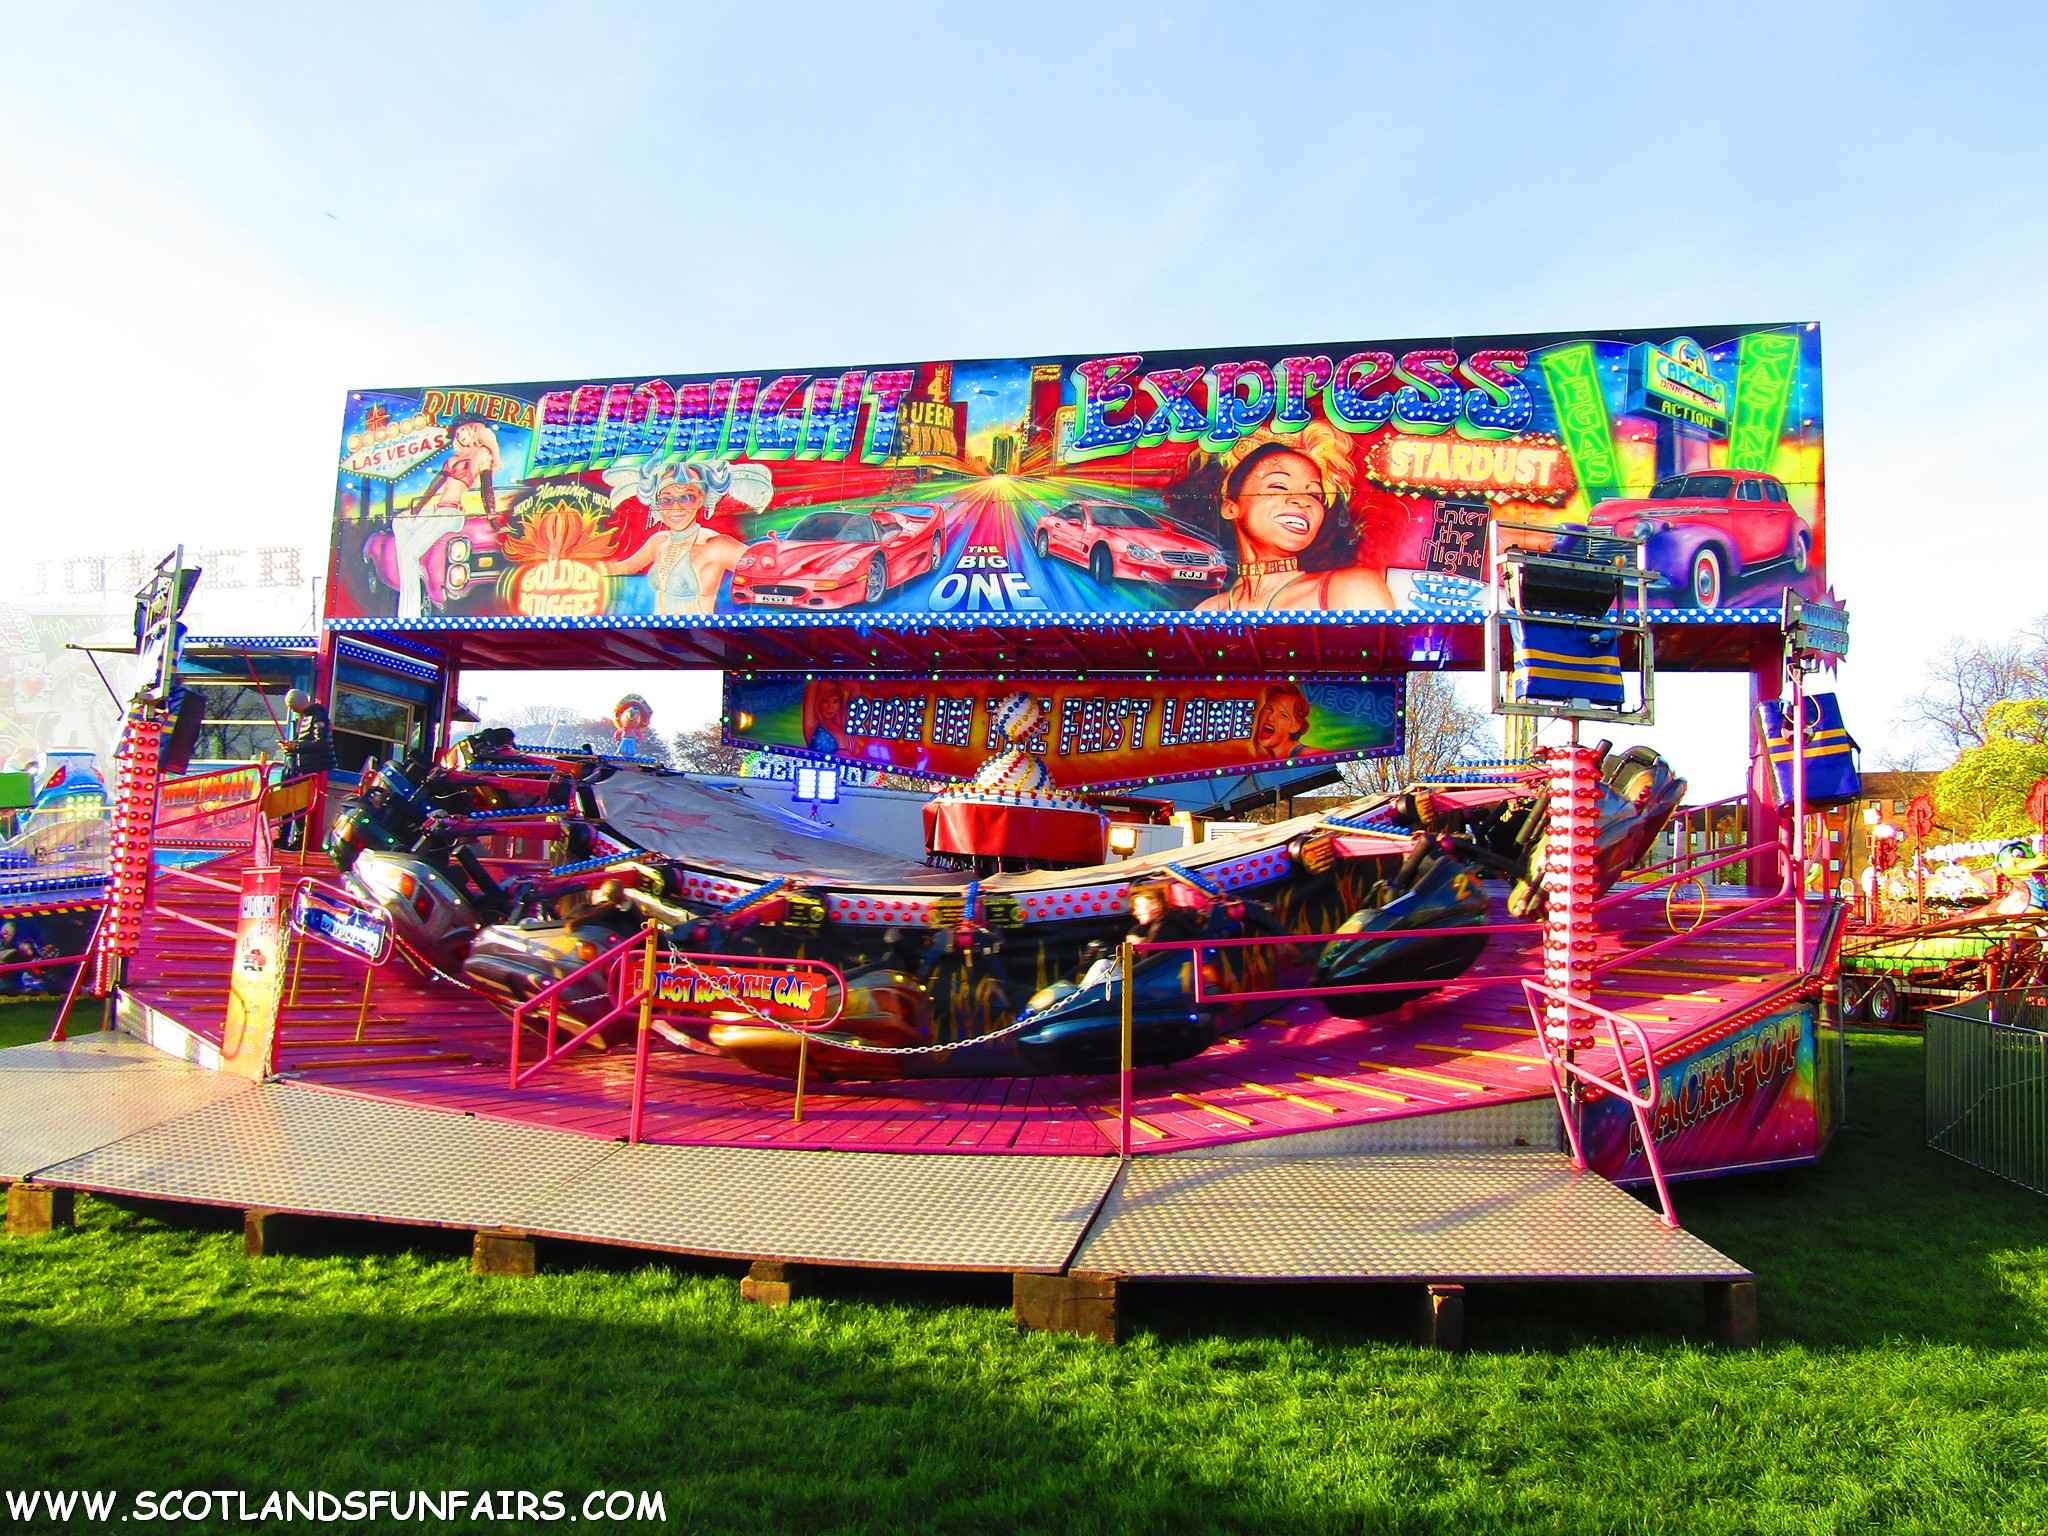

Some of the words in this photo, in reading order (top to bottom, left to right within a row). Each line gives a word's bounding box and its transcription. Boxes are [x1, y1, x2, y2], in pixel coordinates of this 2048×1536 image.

[420, 390, 538, 430] RIVIERA
[528, 368, 916, 479] MIDNIGHT
[1071, 349, 1534, 464] Express
[1551, 348, 1614, 485] VEGAS
[1662, 400, 1713, 428] ACTION
[1734, 337, 1789, 473] CASINO
[352, 452, 381, 471] LAS
[386, 434, 445, 460] VEGAS
[1390, 440, 1559, 486] STARDUST
[1433, 500, 1488, 526] Enter
[967, 545, 1000, 554] THE
[1440, 520, 1474, 545] the
[956, 555, 1009, 570] BIG
[1178, 570, 1204, 579] RJJ
[1421, 538, 1482, 575] Night
[521, 559, 600, 592] GOLDEN
[928, 571, 1048, 611] ONE
[1411, 572, 1487, 588] ENTER
[1424, 582, 1470, 597] THE
[520, 592, 600, 616] NUGGET
[1408, 590, 1482, 607] NIGHT
[1301, 681, 1395, 727] VEGAS
[844, 697, 926, 741] RIDE
[933, 697, 975, 746] IN
[987, 697, 1051, 754] TE
[1059, 697, 1151, 753] FAST
[1160, 697, 1256, 746] LANE
[633, 968, 657, 997] D
[659, 974, 693, 1002] NOT
[694, 971, 740, 1003] ROCK
[742, 974, 773, 1000] THE
[774, 976, 814, 1011] CAR
[1629, 1010, 1802, 1155] JACKPOT
